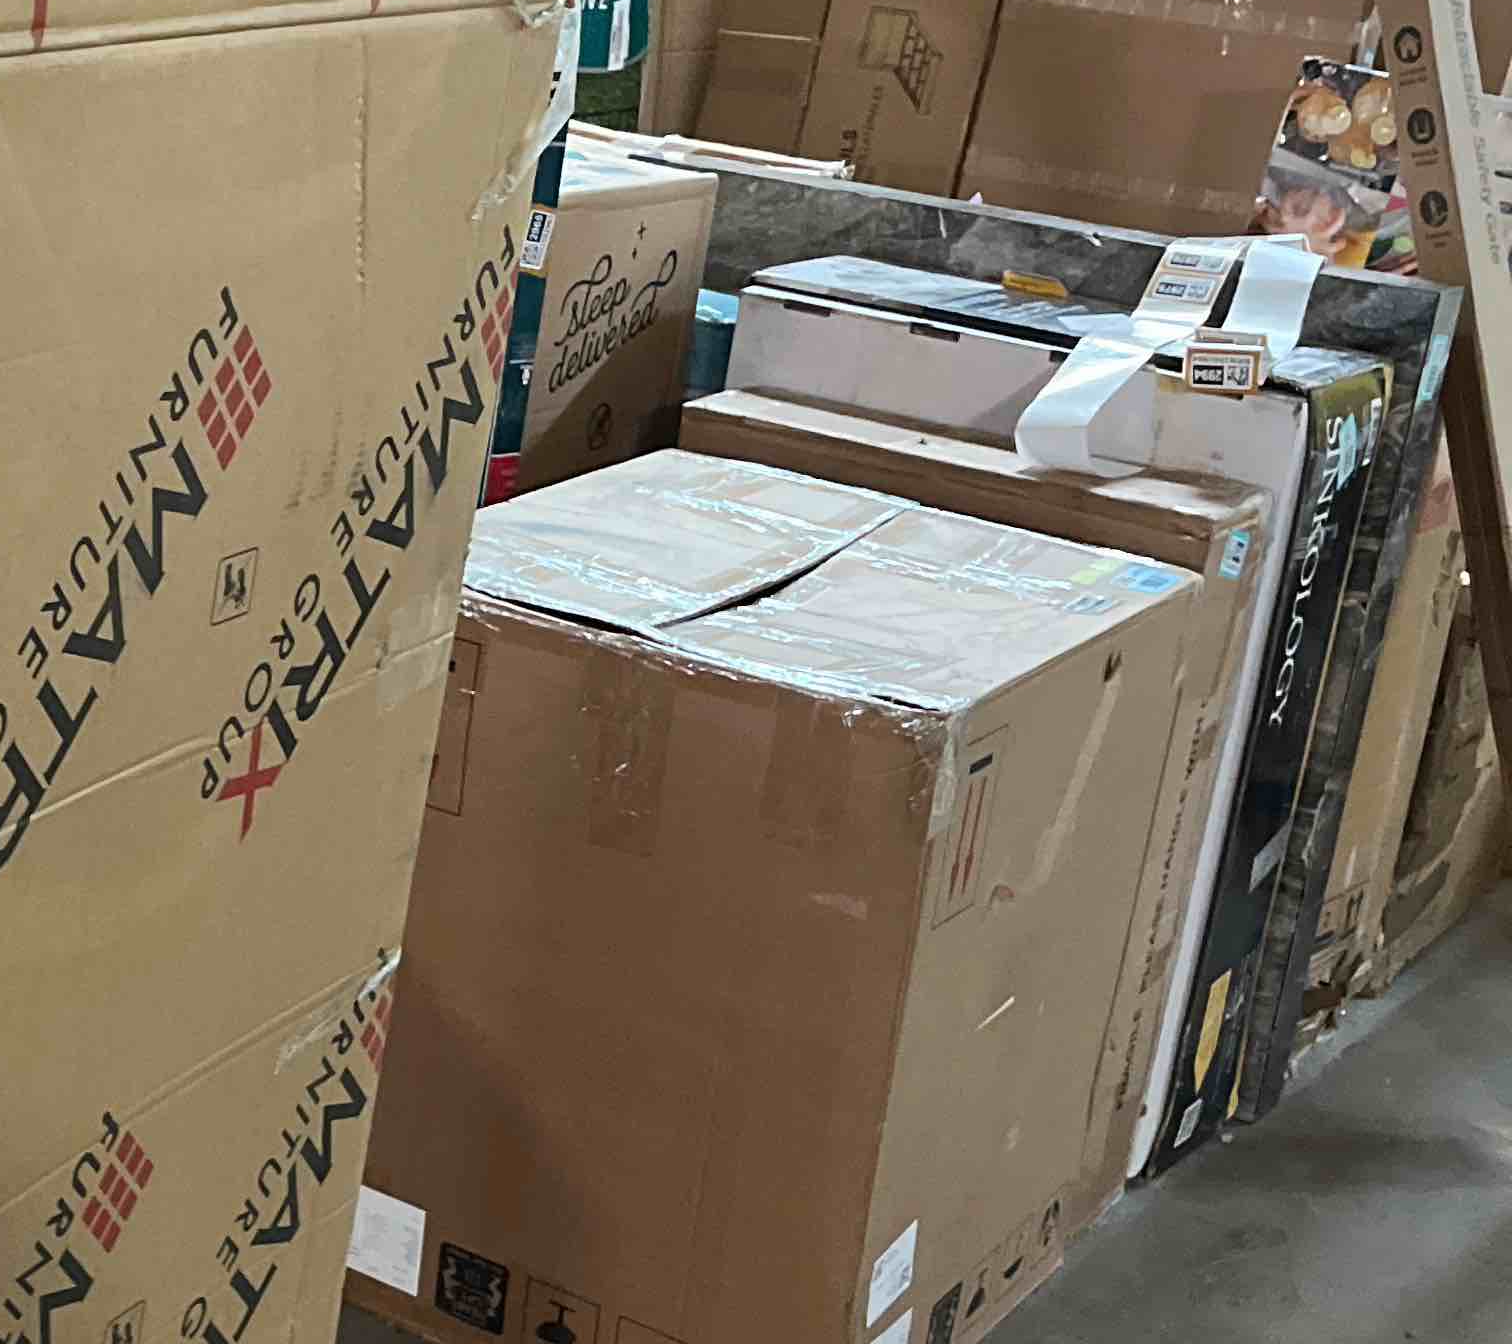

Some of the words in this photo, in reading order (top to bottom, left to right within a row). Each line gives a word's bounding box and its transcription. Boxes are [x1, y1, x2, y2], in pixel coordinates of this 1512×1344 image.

[17, 286, 239, 680] FURNITURE
[331, 223, 515, 557] FURNITURE
[200, 573, 322, 799] GROUP
[215, 356, 485, 844] MATRIX
[1269, 416, 1344, 728] SINKOLOGY
